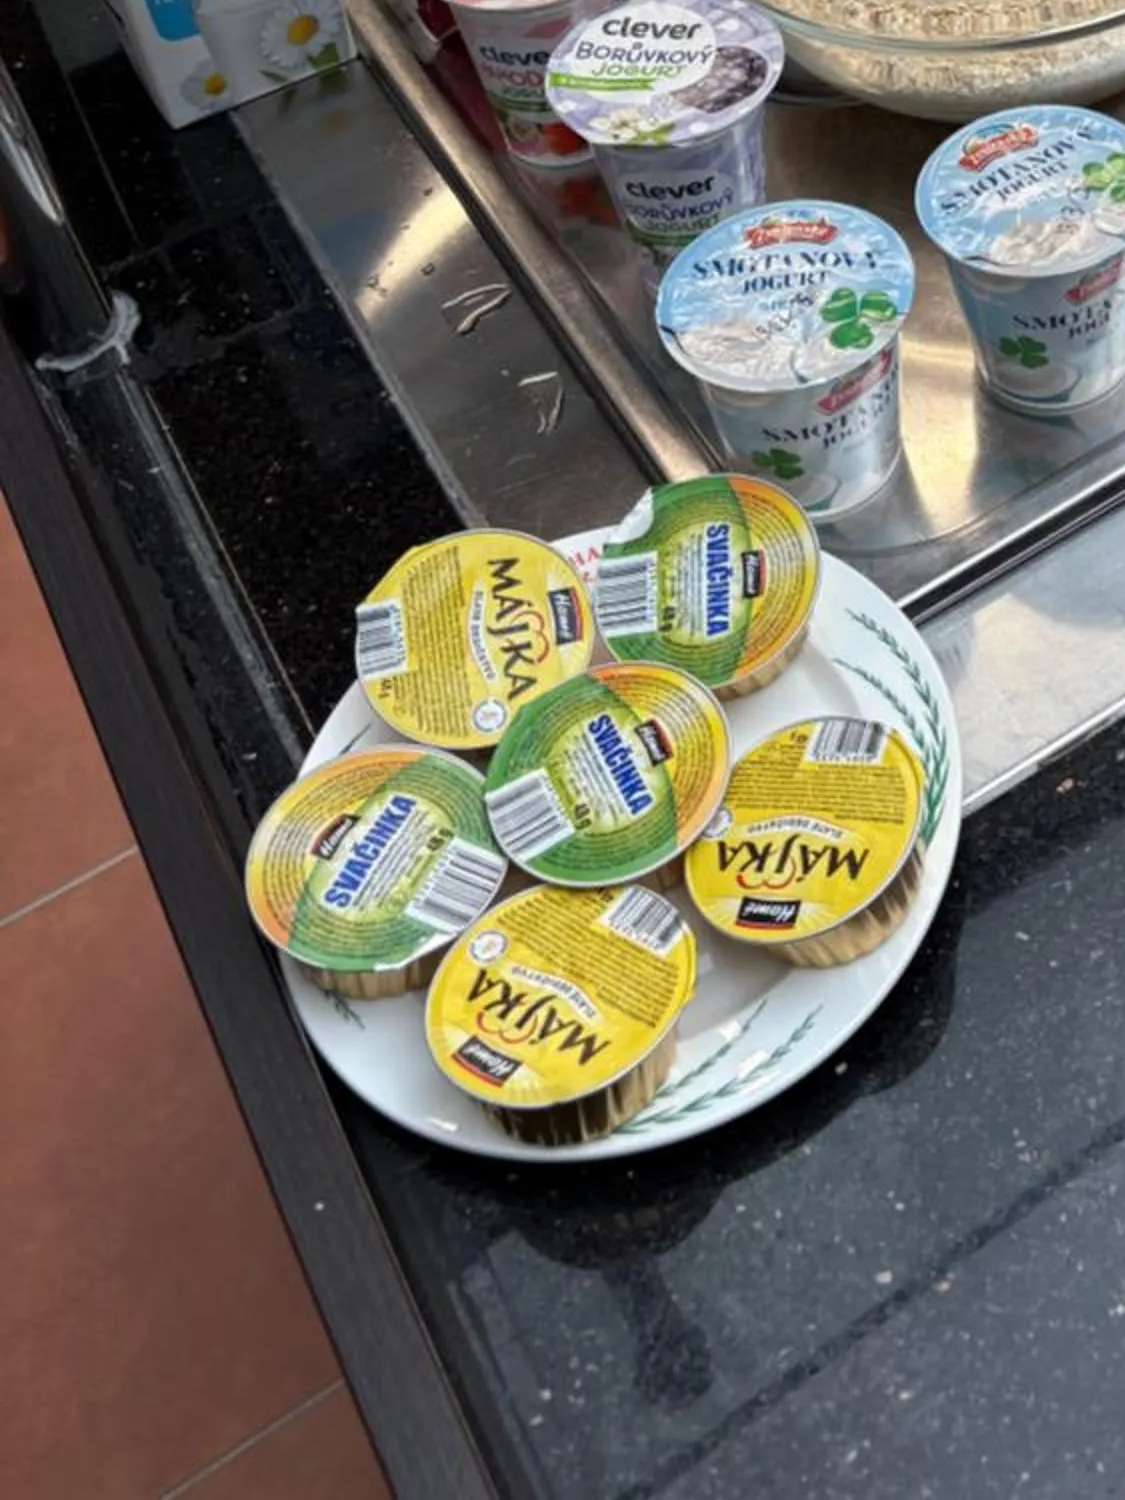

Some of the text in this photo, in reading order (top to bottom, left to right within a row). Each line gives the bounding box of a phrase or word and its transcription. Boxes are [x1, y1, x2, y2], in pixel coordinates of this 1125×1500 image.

[479, 45, 551, 66] cleve
[602, 17, 703, 41] clever
[591, 62, 687, 78] JOGURT
[624, 175, 716, 200] clever
[707, 524, 735, 637] SVAČINKA
[486, 557, 538, 701] MÁJKA
[588, 713, 654, 815] SVAČINKA
[324, 795, 416, 908] SVAČINKA
[716, 834, 870, 883] MÁJKA
[466, 968, 611, 1066] MÁJKA
